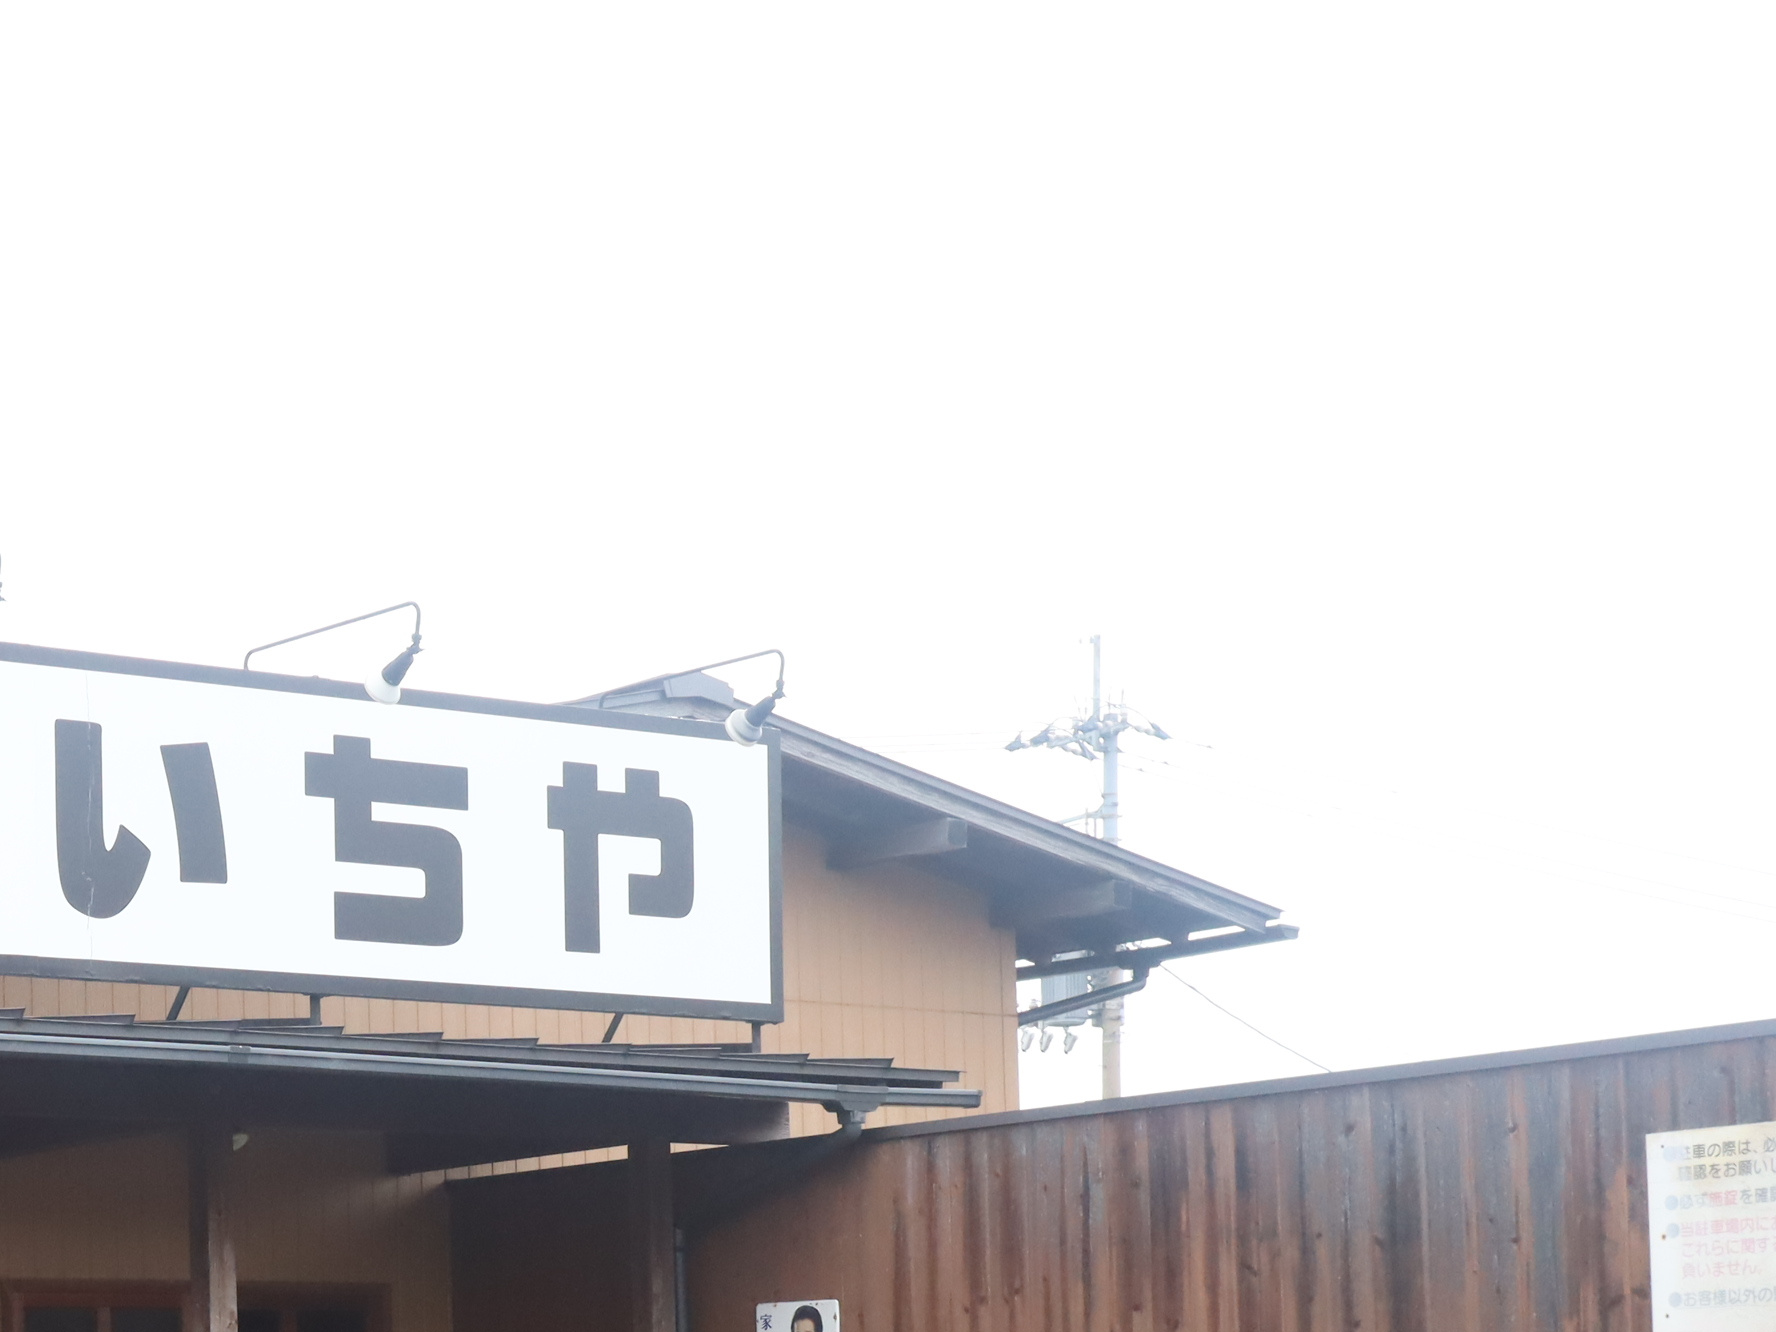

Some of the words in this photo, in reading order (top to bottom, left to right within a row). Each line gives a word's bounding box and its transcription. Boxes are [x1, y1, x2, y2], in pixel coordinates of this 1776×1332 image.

[54, 717, 695, 953] いちや
[1683, 1286, 1776, 1307] お客様以外の
